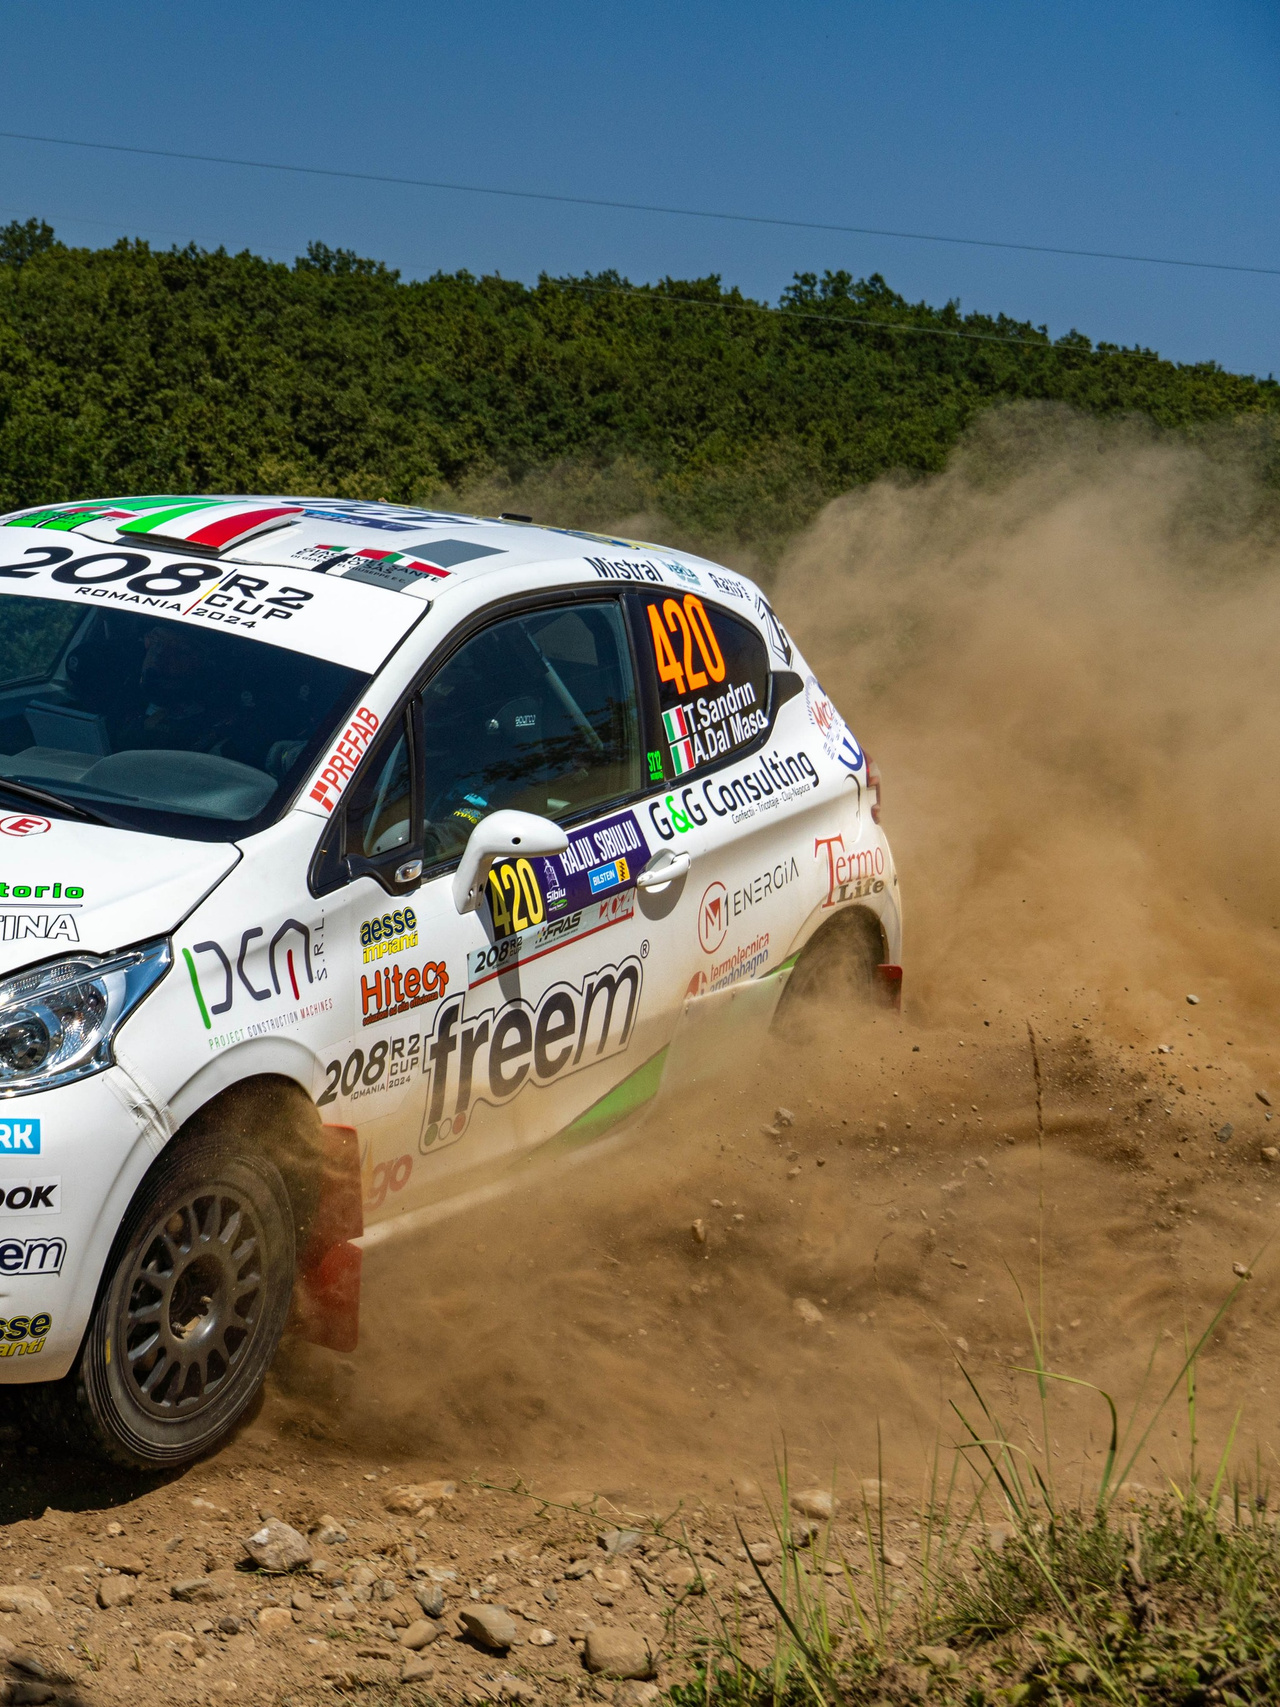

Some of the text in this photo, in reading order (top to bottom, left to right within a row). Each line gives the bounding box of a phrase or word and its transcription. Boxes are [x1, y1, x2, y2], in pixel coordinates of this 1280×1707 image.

[303, 547, 384, 567] GIACMEL
[583, 556, 664, 582] Mistral
[74, 585, 258, 630] ROMANIA 2024
[204, 592, 296, 622] CUP
[218, 573, 314, 611] R2
[647, 593, 726, 695] 420
[321, 707, 379, 793] PREFAB
[694, 720, 731, 764] A.Dal
[648, 750, 820, 841] G&G Consulting
[559, 819, 642, 876] RALIUL SIBIULUI
[592, 869, 616, 886] BILSTEIN
[814, 834, 885, 909] Termo
[836, 876, 885, 904] Life
[488, 858, 544, 937] 420
[546, 887, 566, 903] Sibiu
[360, 906, 417, 947] aesse
[363, 930, 419, 965] impianti
[475, 940, 510, 973] 208
[710, 932, 770, 982] termotecnica
[208, 998, 334, 1050] PROJECT CONSTRUCTION MACHINES
[426, 962, 640, 1127] freem
[315, 1033, 421, 1108] 208 R2
[388, 1075, 412, 1089] 2024
[390, 1056, 420, 1077] CUP
